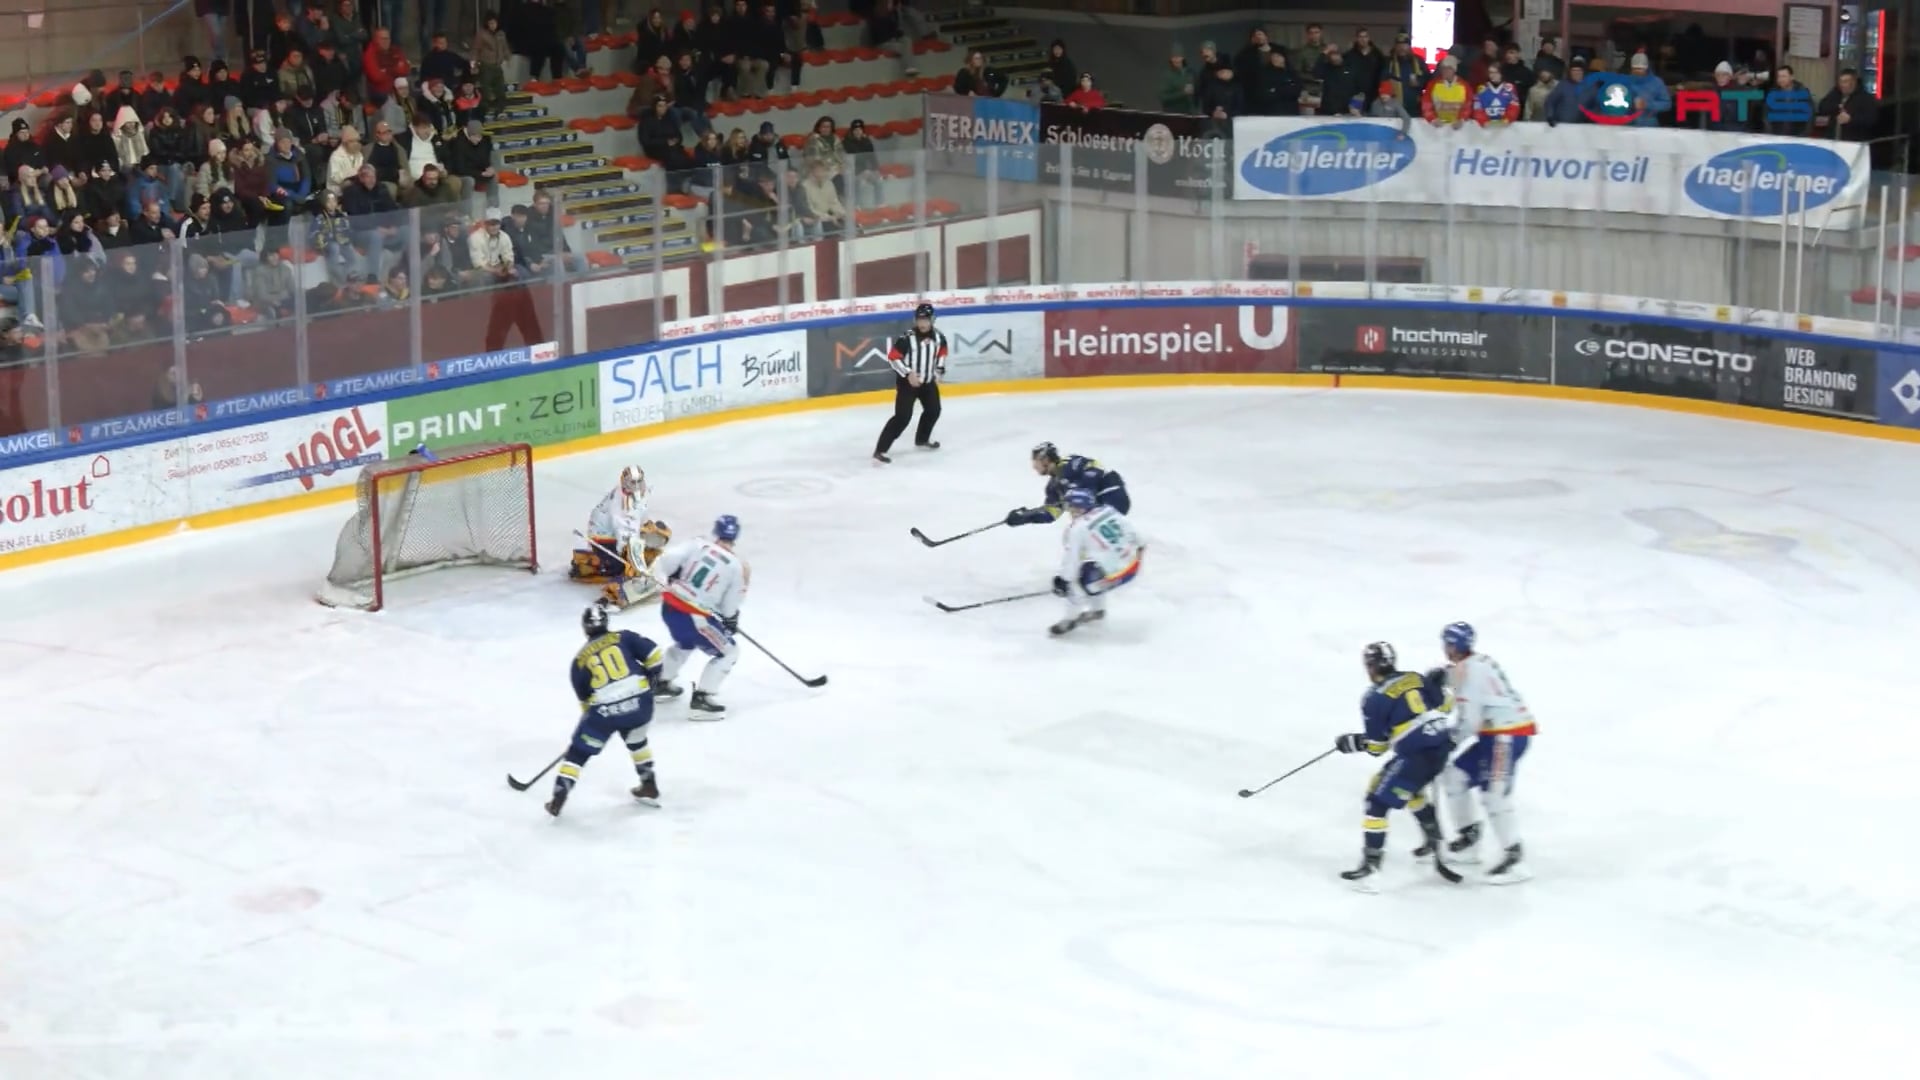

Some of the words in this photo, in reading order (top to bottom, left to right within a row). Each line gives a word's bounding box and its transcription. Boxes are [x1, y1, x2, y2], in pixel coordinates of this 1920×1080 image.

[930, 112, 1035, 148] TERAMEX
[1254, 144, 1404, 174] hagleitner
[1453, 149, 1649, 184] Heimvorteil
[1697, 163, 1838, 195] hagleitner
[1053, 323, 1233, 361] Heimspiel.
[1392, 326, 1488, 346] hochmair
[446, 350, 531, 377] #TEAMKEIL
[1605, 339, 1753, 373] CONECTO
[1785, 347, 1816, 367] WEB
[334, 367, 424, 396] #TEAMKEIL
[612, 343, 722, 404] SACH
[1784, 366, 1857, 392] BRANDING
[1783, 385, 1835, 408] DESIGN
[90, 410, 190, 439] #TEAMKEIL
[393, 403, 507, 446] PRINT
[286, 406, 381, 491] VOGL
[0, 475, 94, 524] olut
